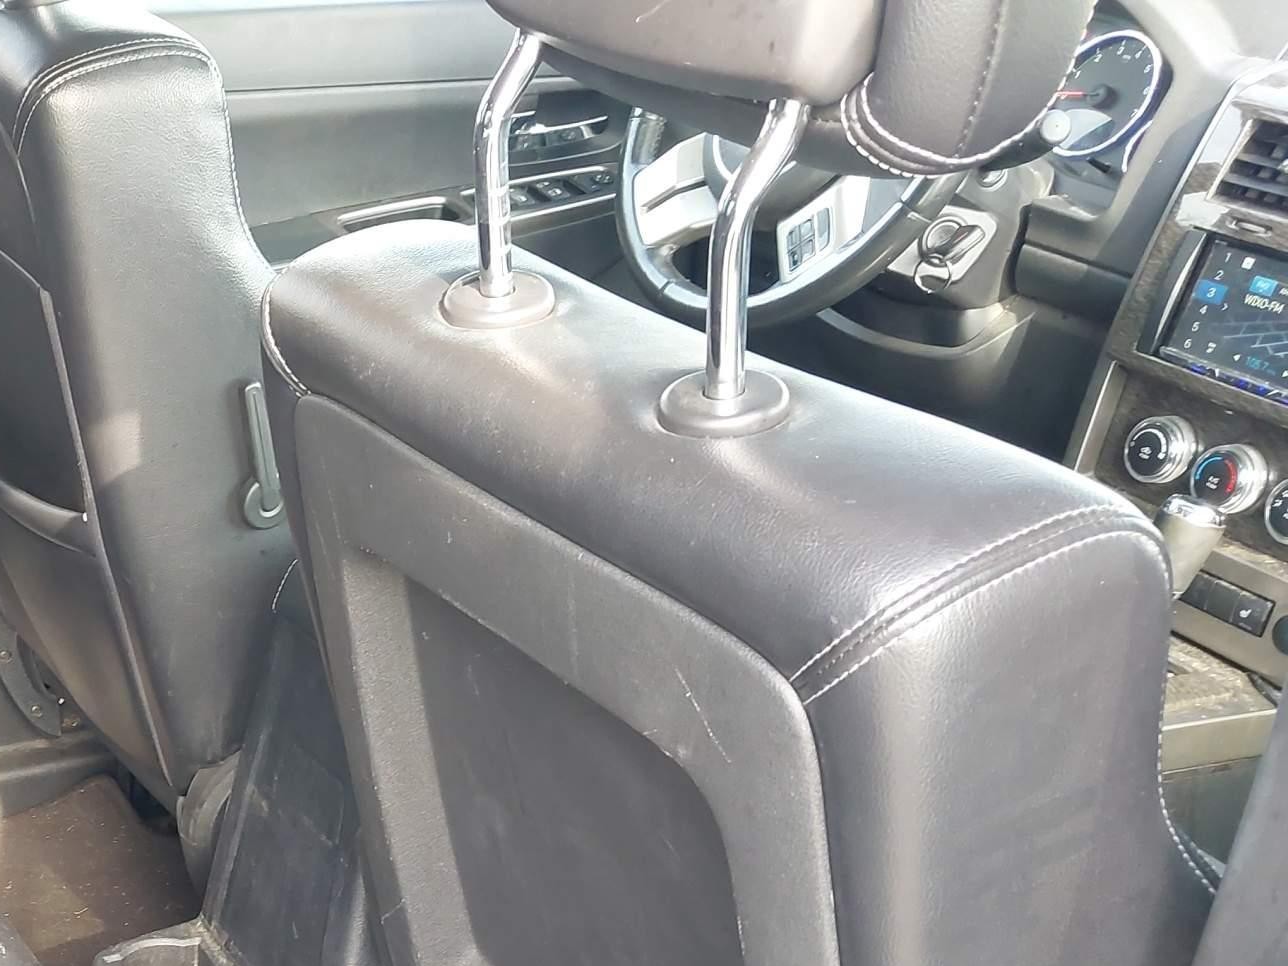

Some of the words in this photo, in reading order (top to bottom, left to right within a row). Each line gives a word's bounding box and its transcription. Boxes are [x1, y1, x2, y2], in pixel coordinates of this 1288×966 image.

[1117, 46, 1124, 55] 3
[1093, 54, 1102, 62] 2
[1143, 64, 1152, 74] 5
[1224, 252, 1231, 263] 1
[1214, 270, 1224, 281] 2
[1207, 287, 1216, 298] 3
[1199, 304, 1209, 315] 4
[1191, 321, 1201, 332] 5
[1183, 338, 1192, 349] 6
